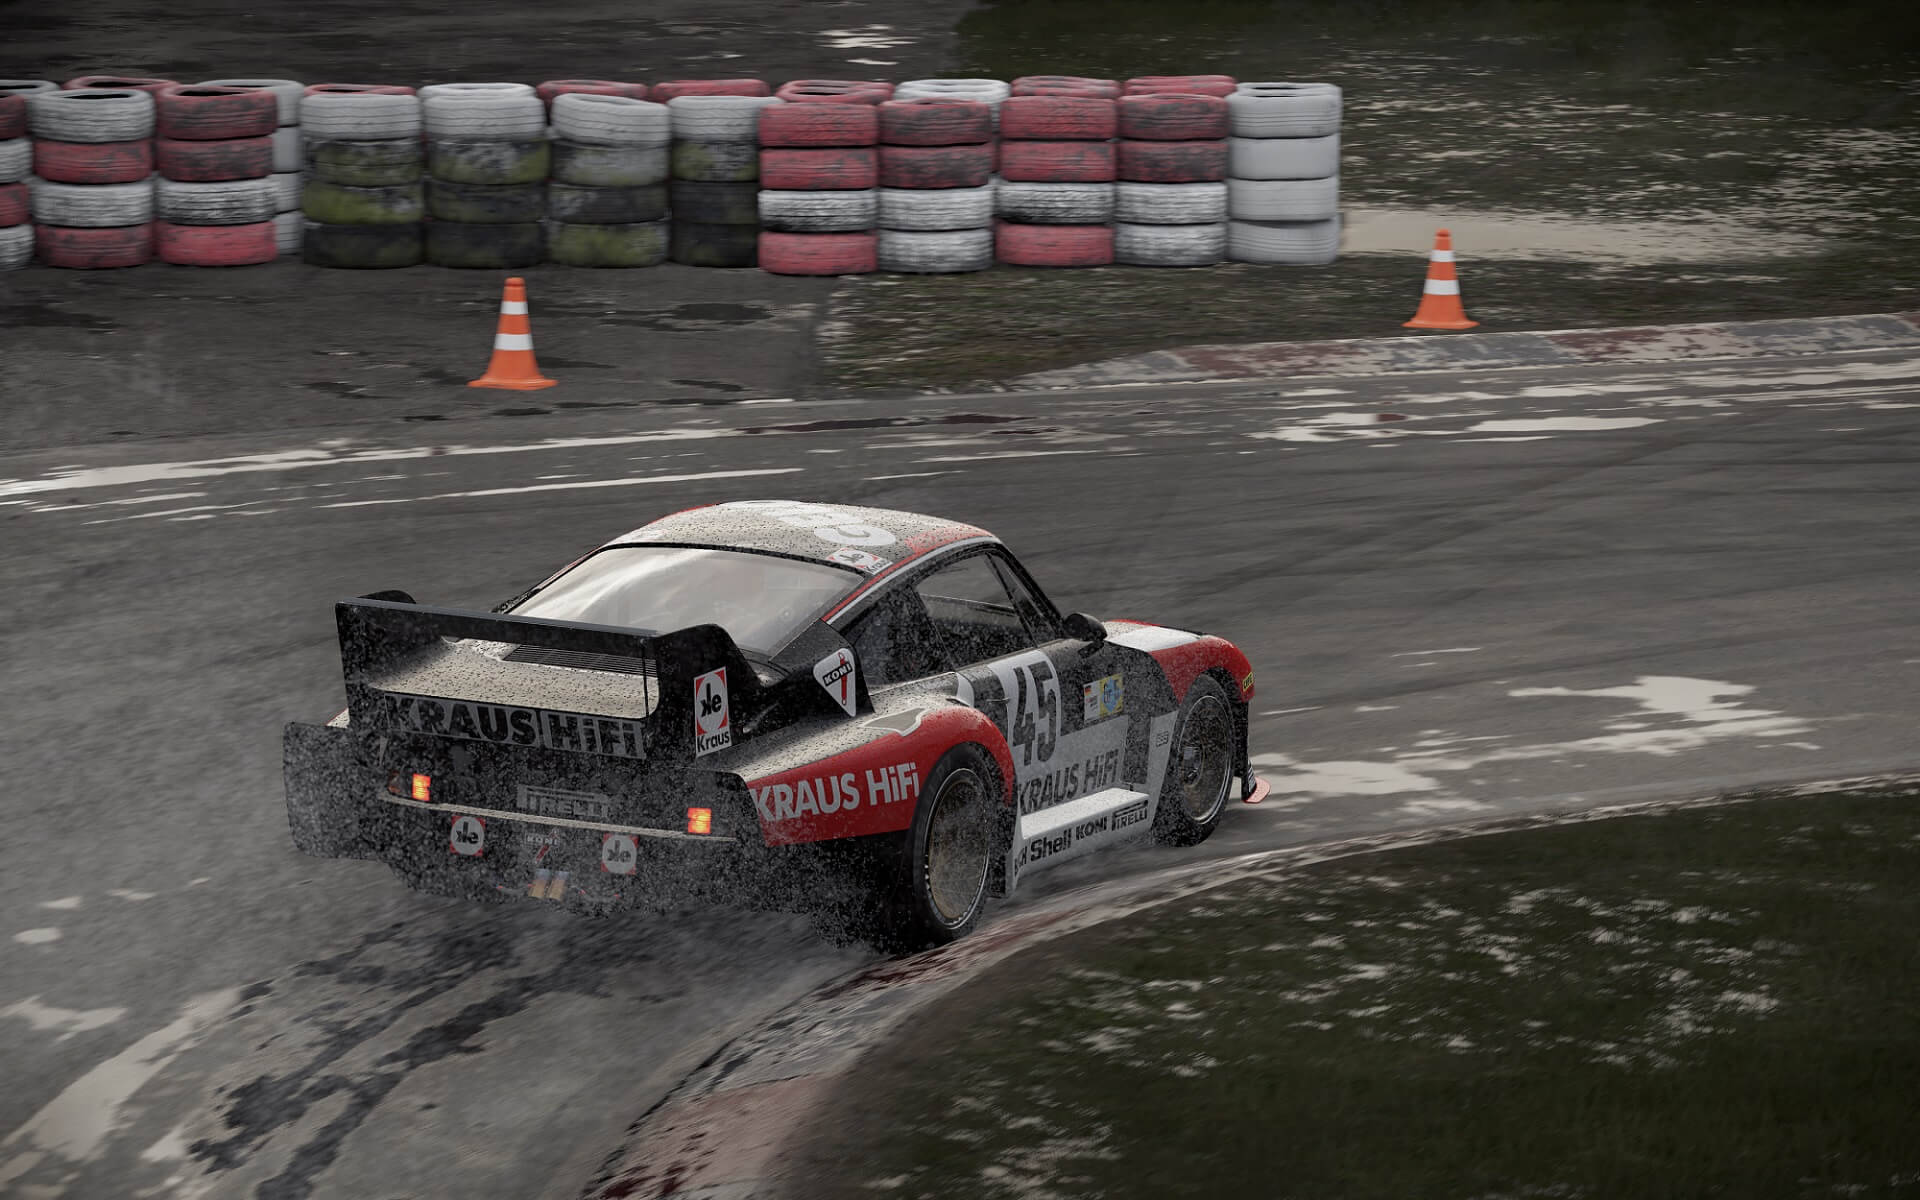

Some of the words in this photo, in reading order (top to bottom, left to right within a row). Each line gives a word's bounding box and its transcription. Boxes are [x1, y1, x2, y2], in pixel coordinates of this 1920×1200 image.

[823, 662, 852, 686] KONI
[385, 692, 539, 747] KRAUS
[547, 712, 643, 759] HiFi
[696, 731, 730, 753] Kraus
[1012, 660, 1057, 767] 45
[749, 772, 861, 822] KRAUS
[864, 761, 921, 807] HiFi
[1017, 762, 1080, 816] KRAUS
[1082, 748, 1119, 794] HiFi
[1030, 827, 1072, 862] Shell
[1075, 815, 1107, 841] KONI
[1111, 799, 1149, 832] PIRELLI
